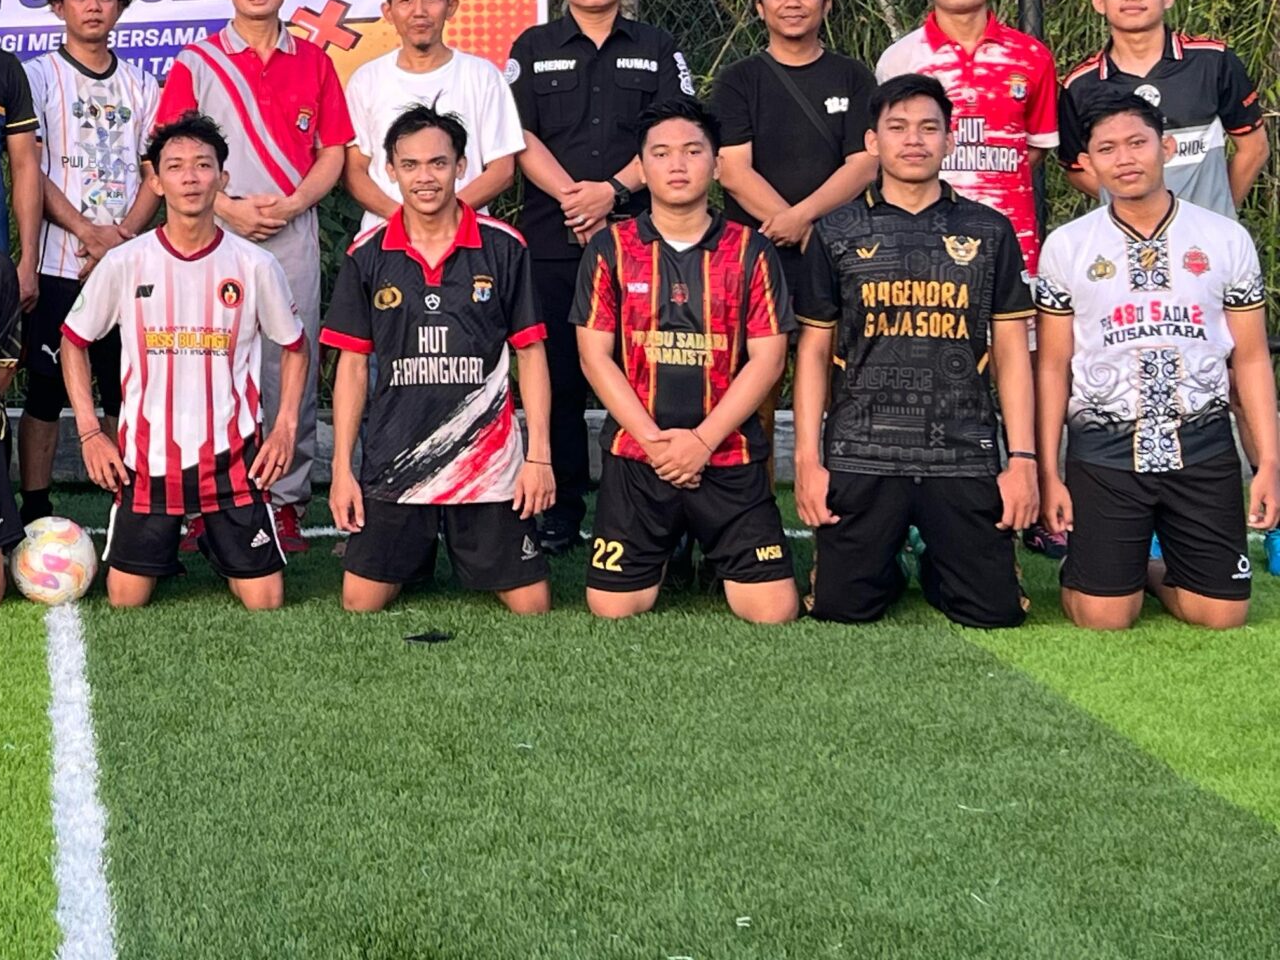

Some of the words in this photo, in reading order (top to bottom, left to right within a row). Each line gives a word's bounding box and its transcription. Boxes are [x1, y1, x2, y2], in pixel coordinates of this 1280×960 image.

[533, 59, 577, 74] RHENDY
[616, 58, 658, 72] HUMAS
[957, 117, 985, 144] HUT
[61, 155, 84, 169] PWI
[863, 311, 970, 340] GAJASORA
[1102, 323, 1209, 348] NUSANTARA
[418, 326, 449, 354] HUT
[591, 538, 625, 572] 22
